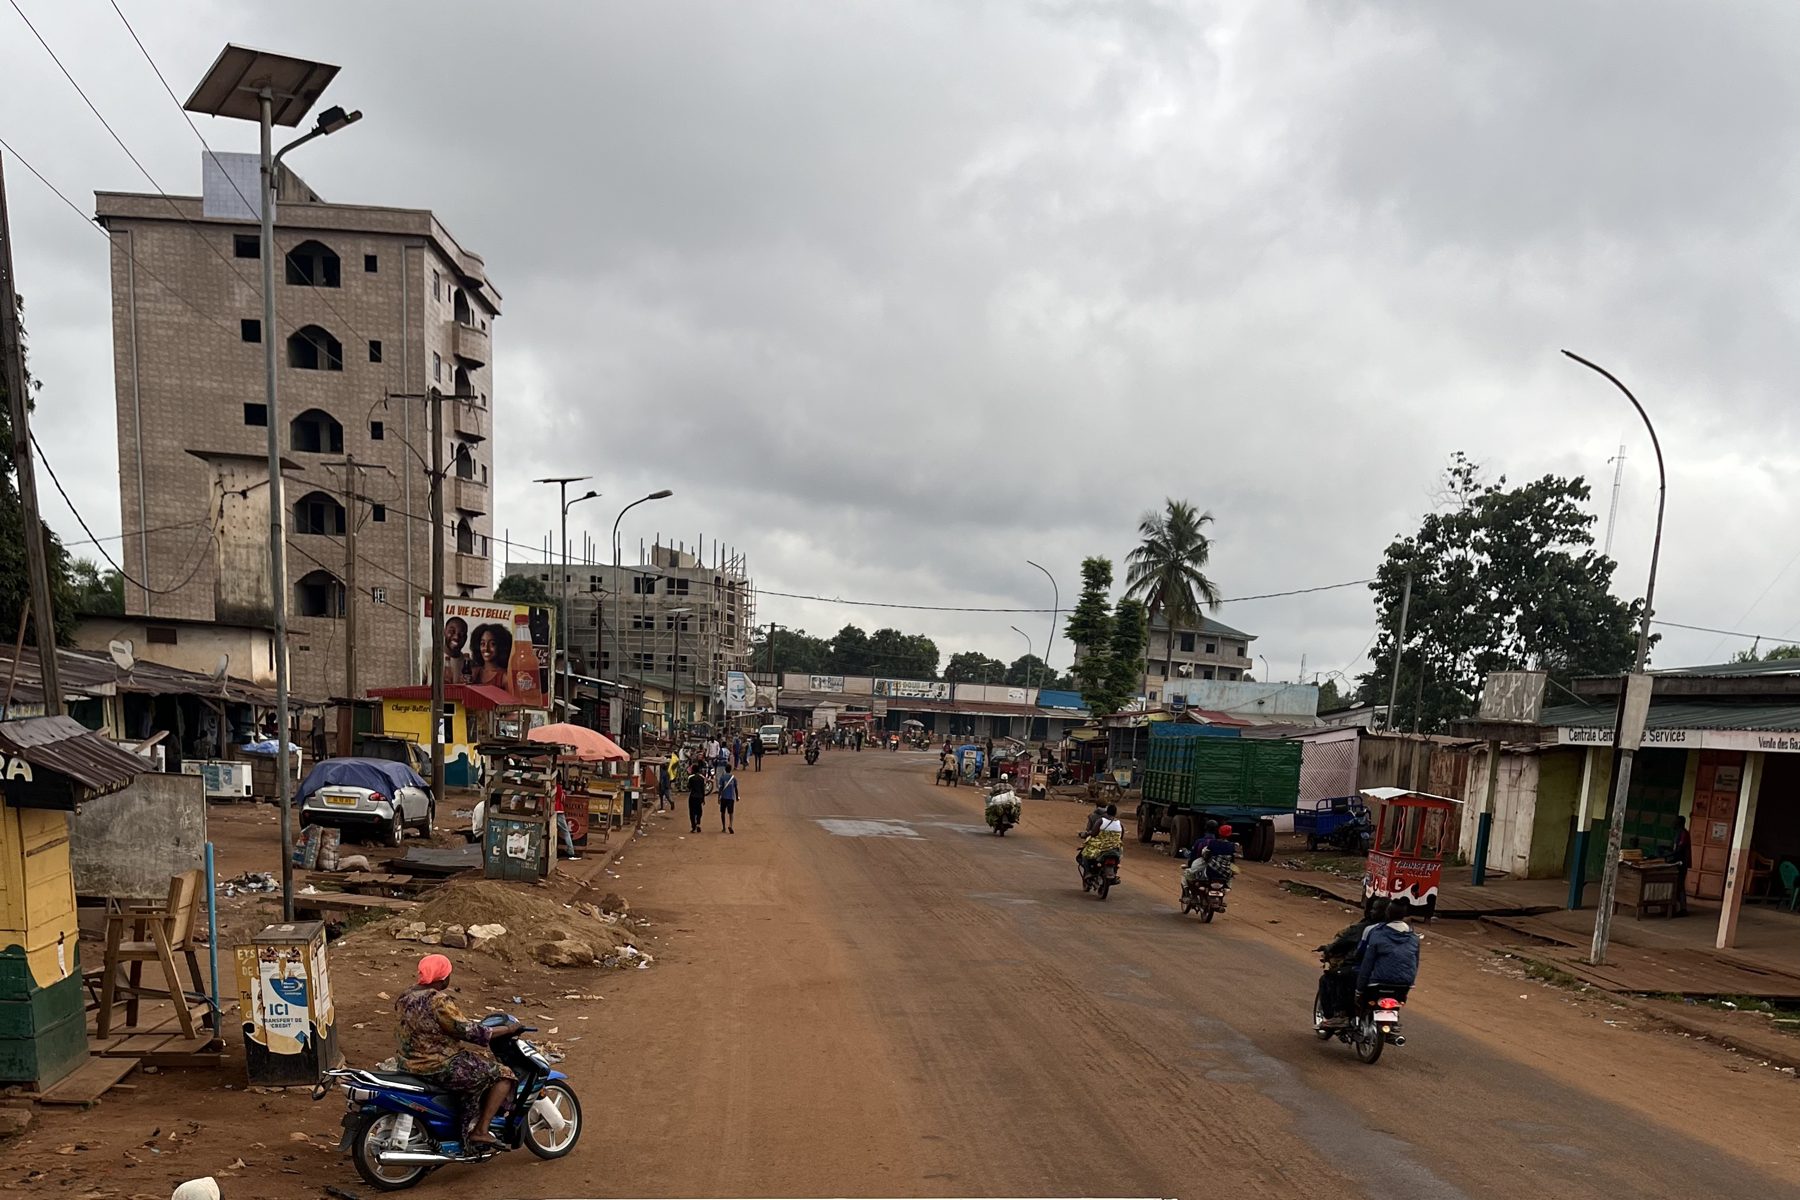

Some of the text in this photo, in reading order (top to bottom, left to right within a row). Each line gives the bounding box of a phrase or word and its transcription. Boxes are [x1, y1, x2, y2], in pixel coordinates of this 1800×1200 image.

[446, 605, 511, 621] LA VIE EST BELLE!
[1568, 728, 1596, 742] Centrale
[1598, 729, 1614, 742] Cent
[1649, 730, 1686, 743] Services
[269, 1003, 289, 1016] ICI
